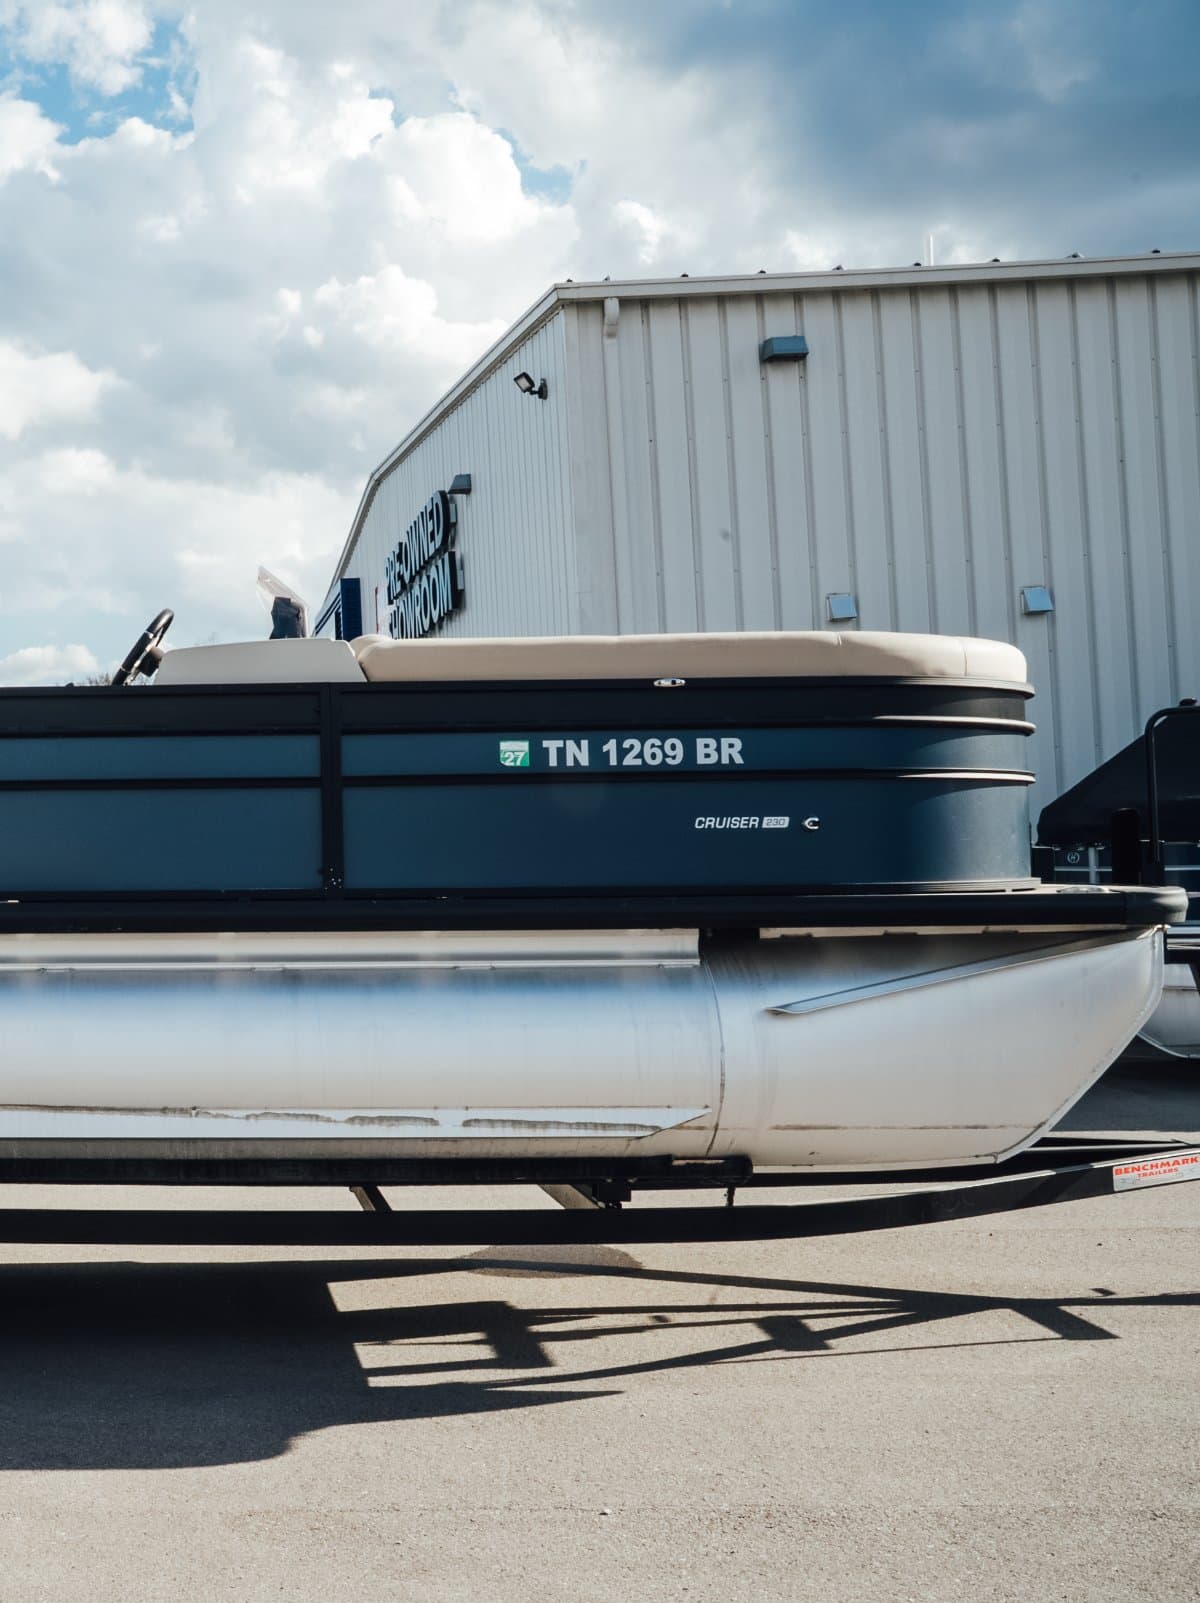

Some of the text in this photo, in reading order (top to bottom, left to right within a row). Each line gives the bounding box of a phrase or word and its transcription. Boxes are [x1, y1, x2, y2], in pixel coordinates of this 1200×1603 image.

[385, 490, 448, 602] PRE-OWNED
[504, 751, 526, 767] 27
[542, 737, 744, 767] TN 1269 BR
[695, 816, 787, 829] CRUISER 230
[1114, 1157, 1199, 1176] BENCHMARK
[1137, 1167, 1179, 1178] TRAILERS
